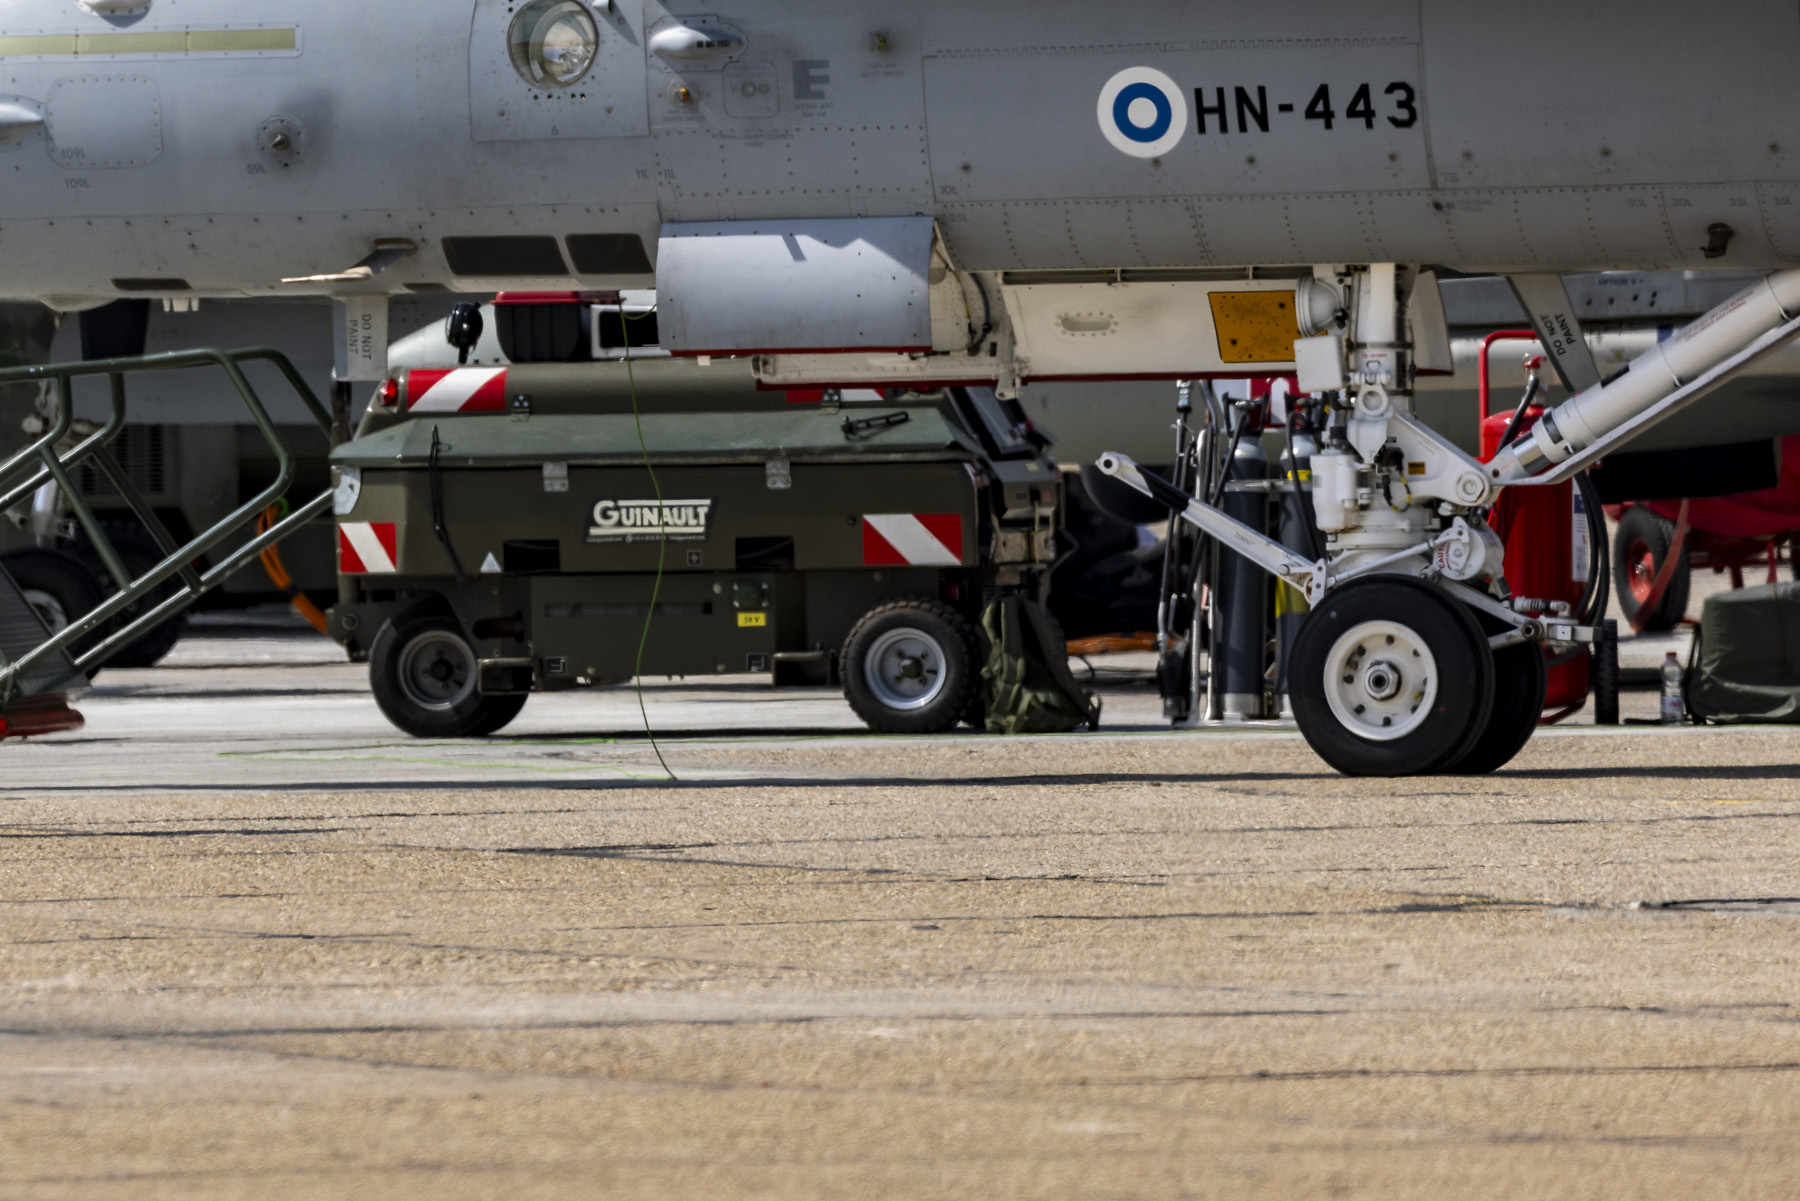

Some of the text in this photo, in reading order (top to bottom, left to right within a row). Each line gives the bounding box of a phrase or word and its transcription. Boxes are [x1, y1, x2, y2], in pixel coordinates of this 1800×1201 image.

[792, 59, 830, 100] E
[1194, 82, 1418, 135] HN-443
[551, 125, 559, 136] 6
[60, 147, 87, 160] 109L
[64, 177, 90, 190] 109L
[246, 163, 266, 176] 59L
[940, 184, 959, 196] 10L
[348, 319, 359, 355] PAINT
[361, 313, 372, 360] DO NOT
[1540, 314, 1567, 356] DO NOT
[1554, 312, 1577, 345] PAINT
[593, 499, 710, 527] GUINAULT
